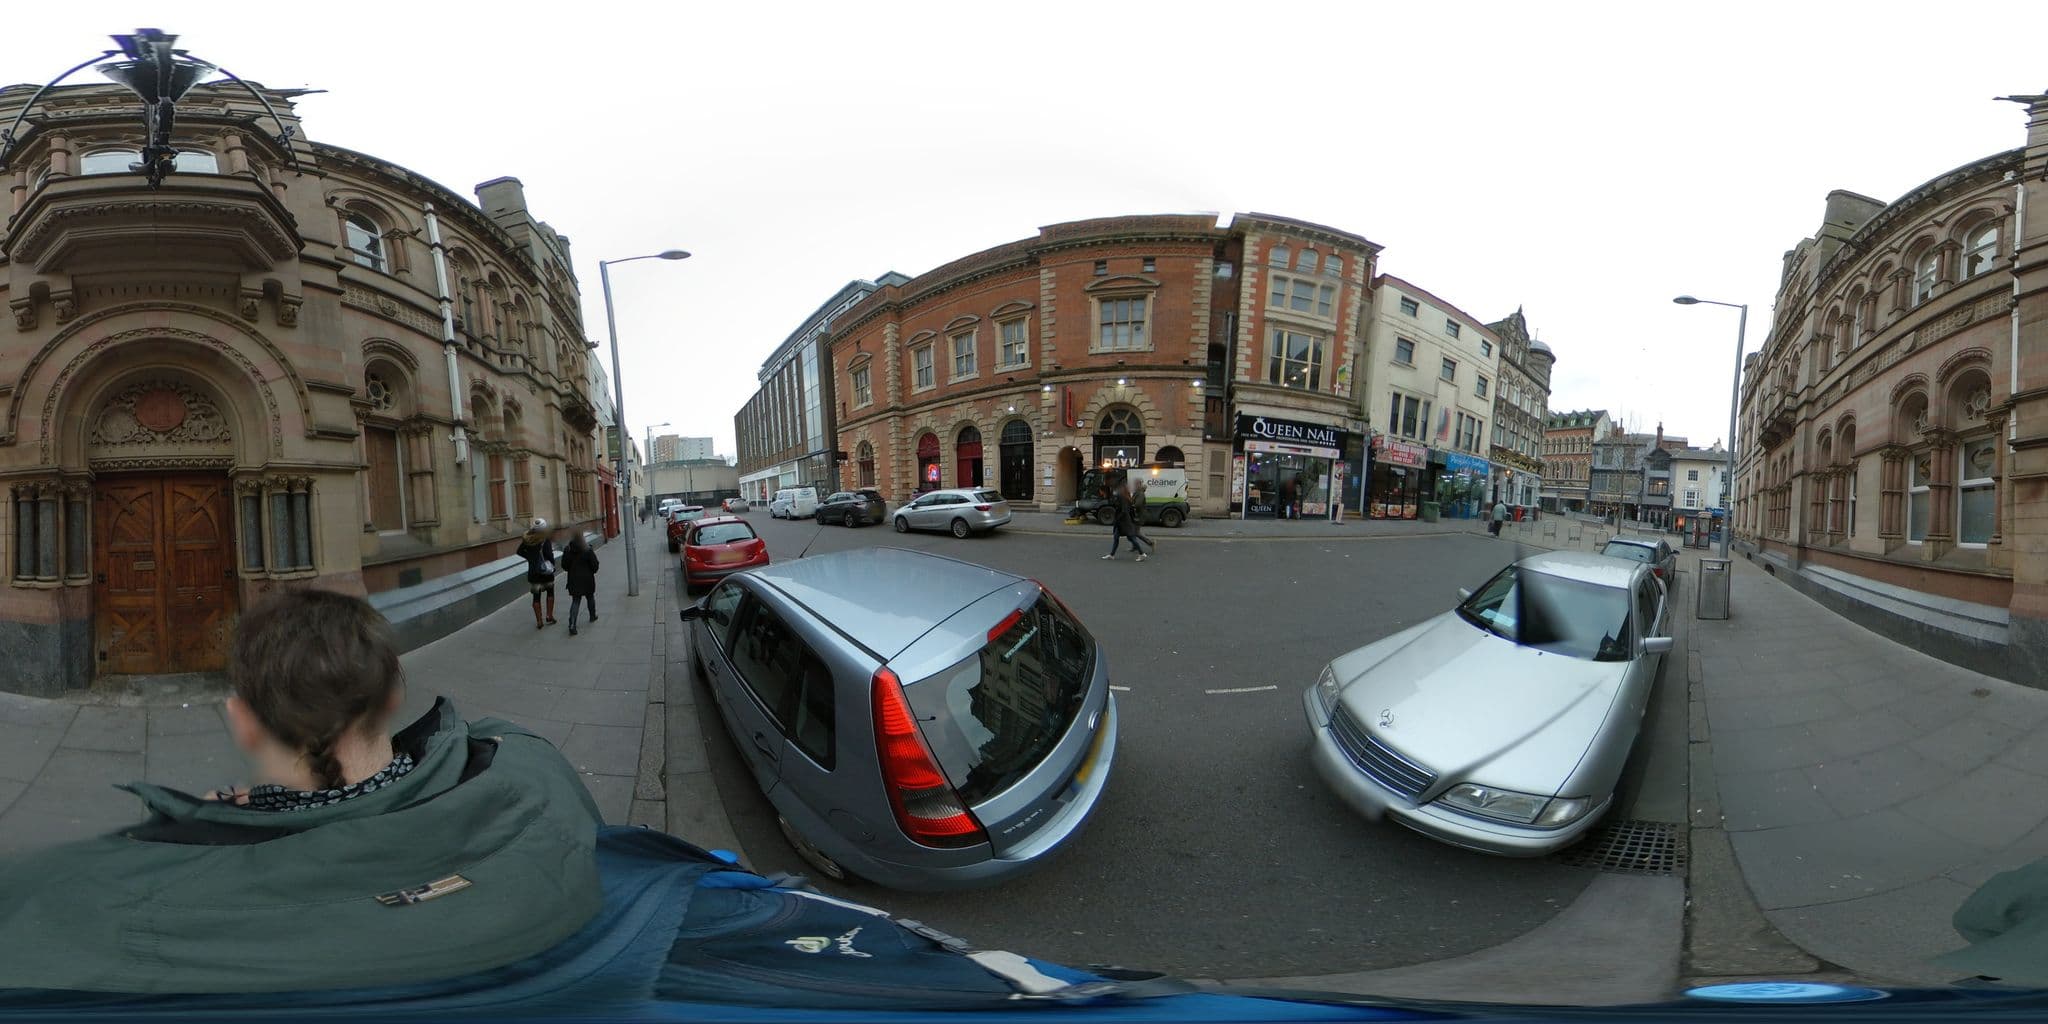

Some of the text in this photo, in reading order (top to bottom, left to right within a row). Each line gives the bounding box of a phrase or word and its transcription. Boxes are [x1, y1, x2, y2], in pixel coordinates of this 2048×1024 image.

[1253, 418, 1303, 438] QUEEN
[1307, 428, 1336, 442] NAIL
[1147, 478, 1177, 487] cleaner
[1251, 504, 1272, 512] QUEEN
